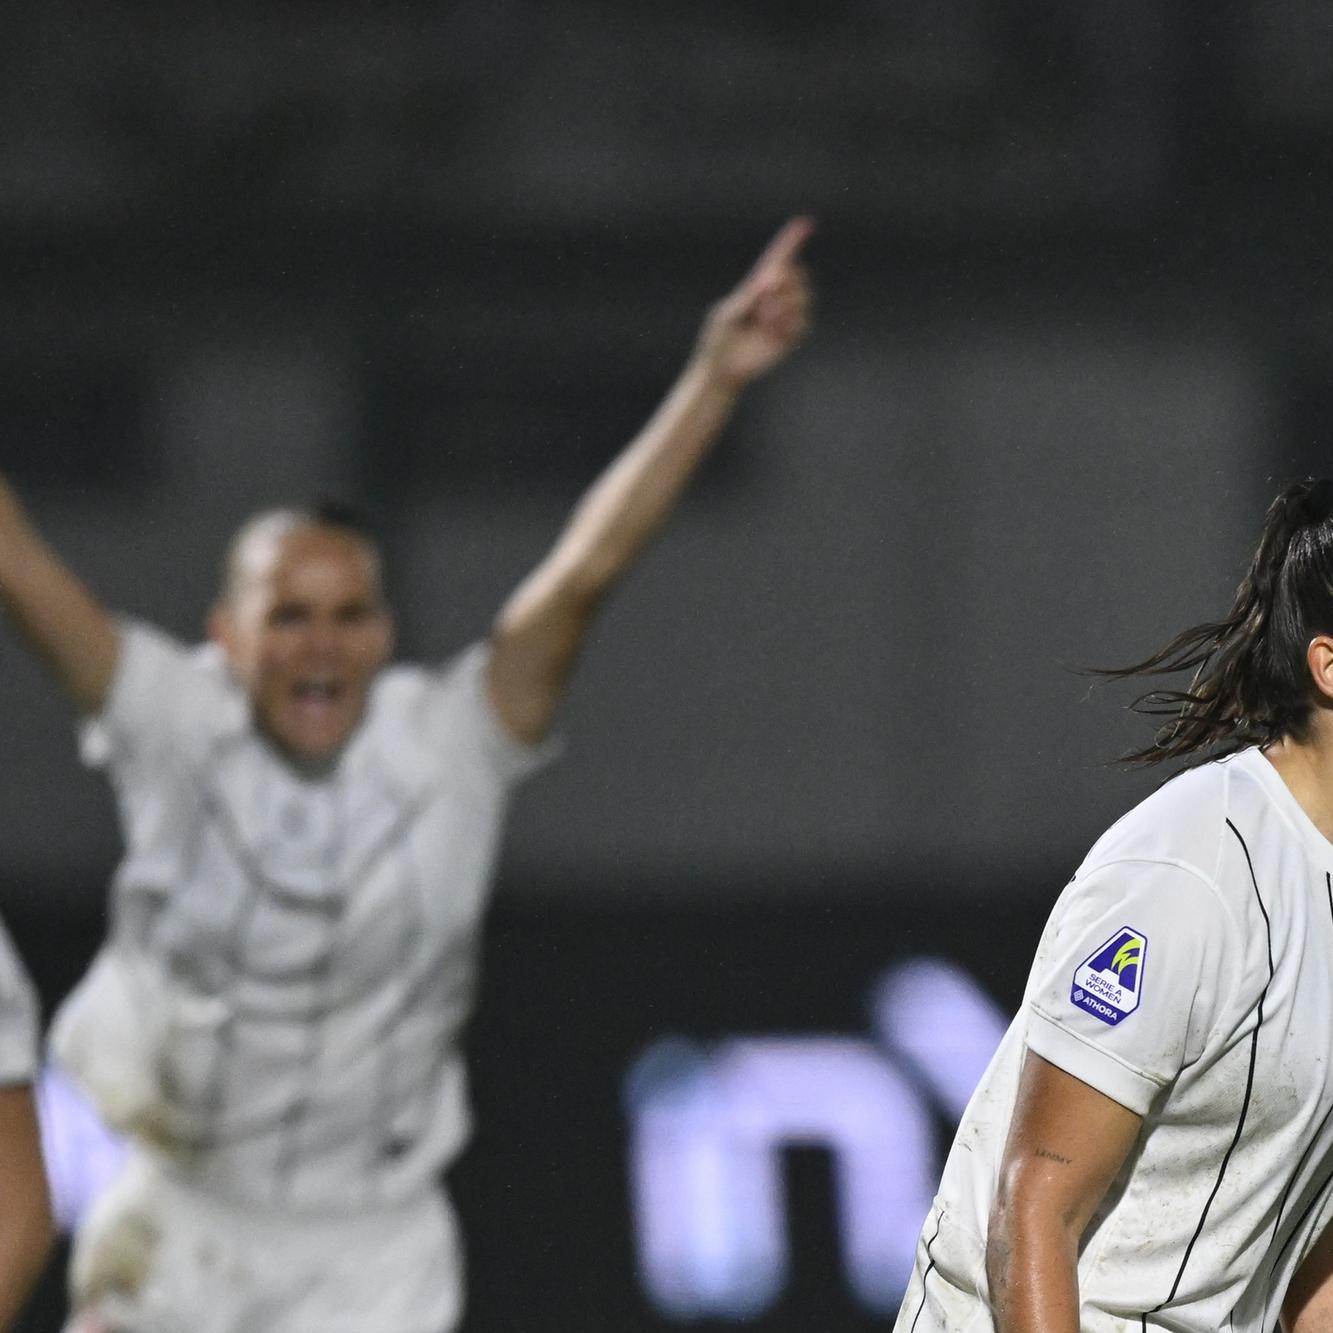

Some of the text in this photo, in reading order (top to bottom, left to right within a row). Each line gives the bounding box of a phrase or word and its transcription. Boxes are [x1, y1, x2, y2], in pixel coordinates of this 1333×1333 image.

[1085, 979, 1122, 1004] WOMEN
[1090, 973, 1122, 997] SERIE A
[1082, 996, 1117, 1021] ATHORA
